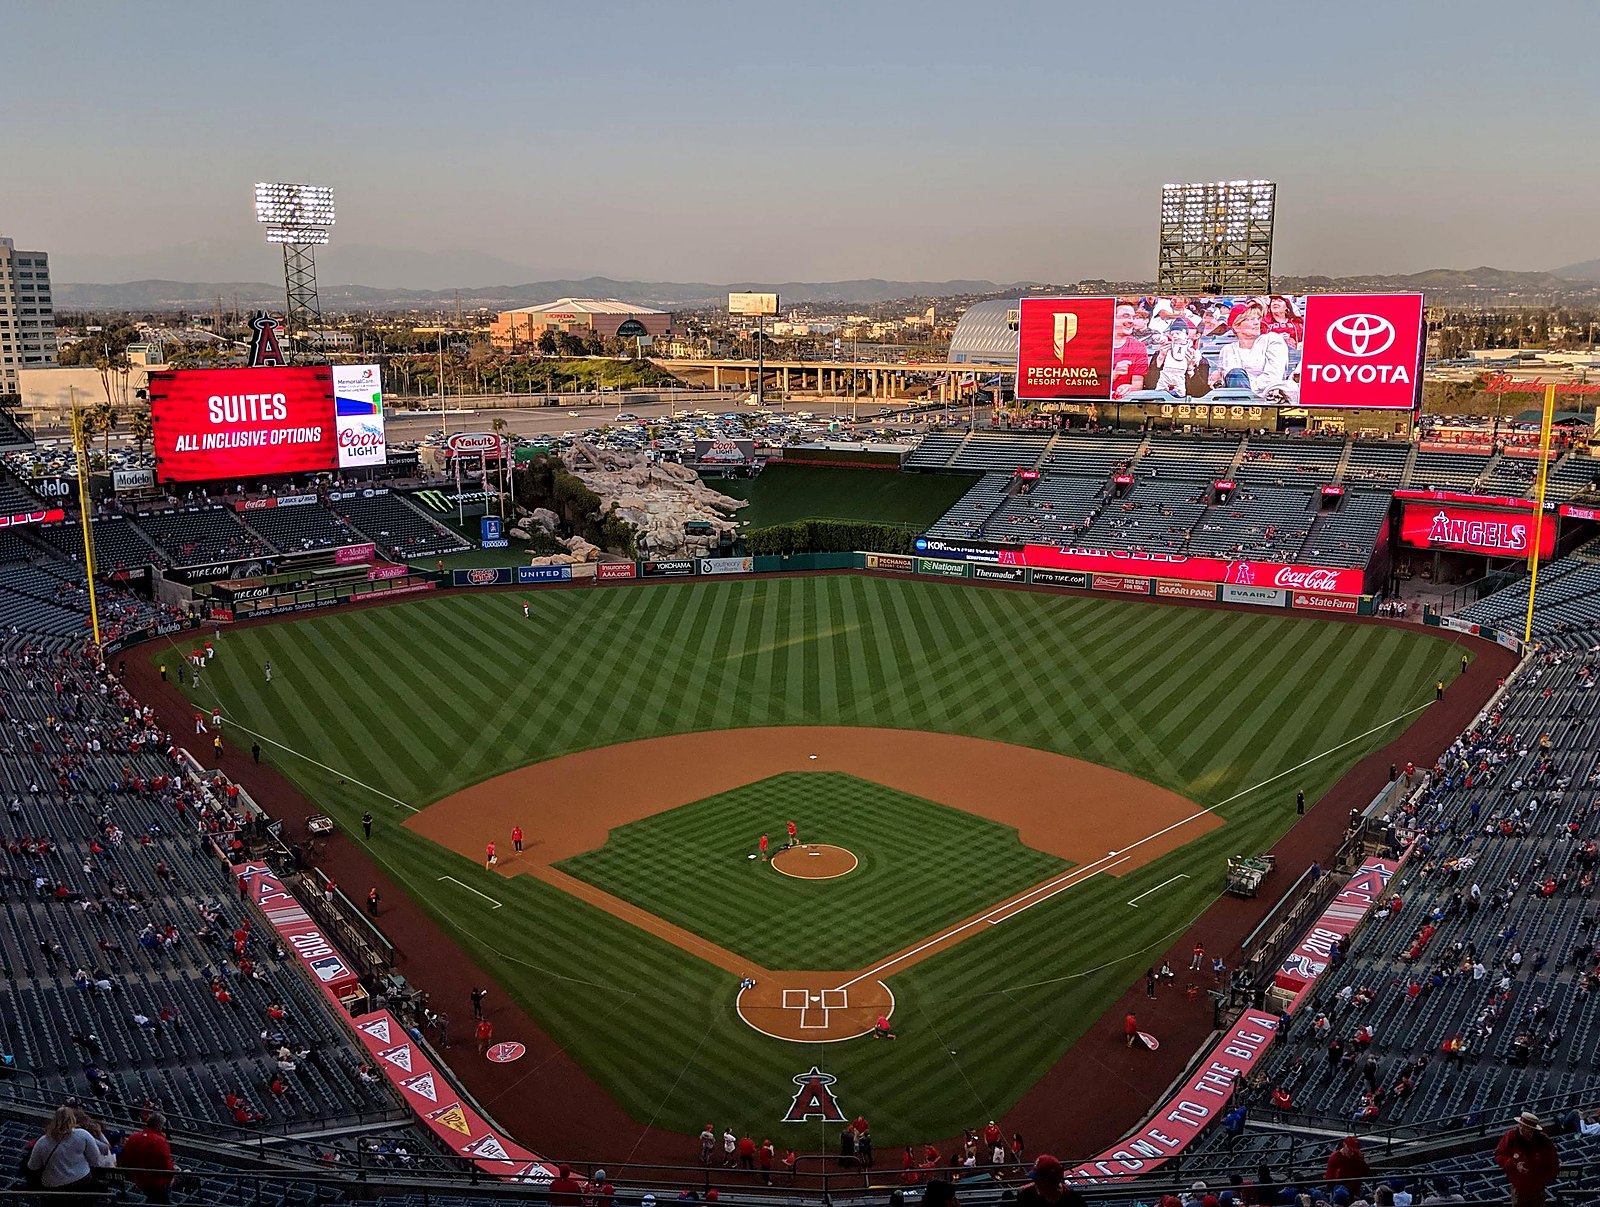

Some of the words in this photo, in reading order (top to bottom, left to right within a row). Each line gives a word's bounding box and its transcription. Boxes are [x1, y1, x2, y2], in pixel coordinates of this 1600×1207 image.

[1028, 367, 1098, 378] PECHANGA
[1308, 364, 1410, 384] TOYOTA
[1028, 378, 1062, 386] RESORT
[1064, 378, 1100, 386] CASINO
[208, 394, 287, 424] SUITES
[1040, 402, 1058, 412] Captain
[1059, 402, 1080, 413] Morgan
[176, 436, 200, 452] ALL
[202, 430, 267, 450] INCLUSIVE
[270, 427, 321, 445] OPTIONS
[338, 428, 384, 447] Coors
[459, 438, 493, 446] Yakult
[348, 446, 378, 456] LIGHT
[711, 440, 737, 449] Coors
[118, 474, 149, 485] Modelo
[245, 499, 267, 509] Coca-Cola
[1567, 506, 1594, 519] ANGELS
[1428, 511, 1527, 550] ANGELS
[192, 565, 229, 578] TIRE.COM
[932, 561, 964, 572] National
[976, 569, 1016, 579] Thermador
[1054, 575, 1085, 584] TIRE.COM
[1274, 567, 1341, 591] Coca-Cola
[1159, 586, 1189, 595] SAFARI
[1190, 589, 1213, 597] PARK
[1309, 597, 1331, 606] State
[1332, 598, 1355, 609] Farm
[248, 609, 270, 617] StubHub
[158, 622, 181, 635] Modelo
[289, 932, 333, 958] 2019
[1302, 928, 1342, 958] 2019
[1247, 1016, 1279, 1030] A
[1224, 1031, 1266, 1060] BIG
[1194, 1062, 1241, 1096] THE
[780, 1066, 848, 1122] A
[443, 1112, 462, 1124] '02
[1168, 1101, 1208, 1127] TO
[481, 1142, 500, 1156] '04
